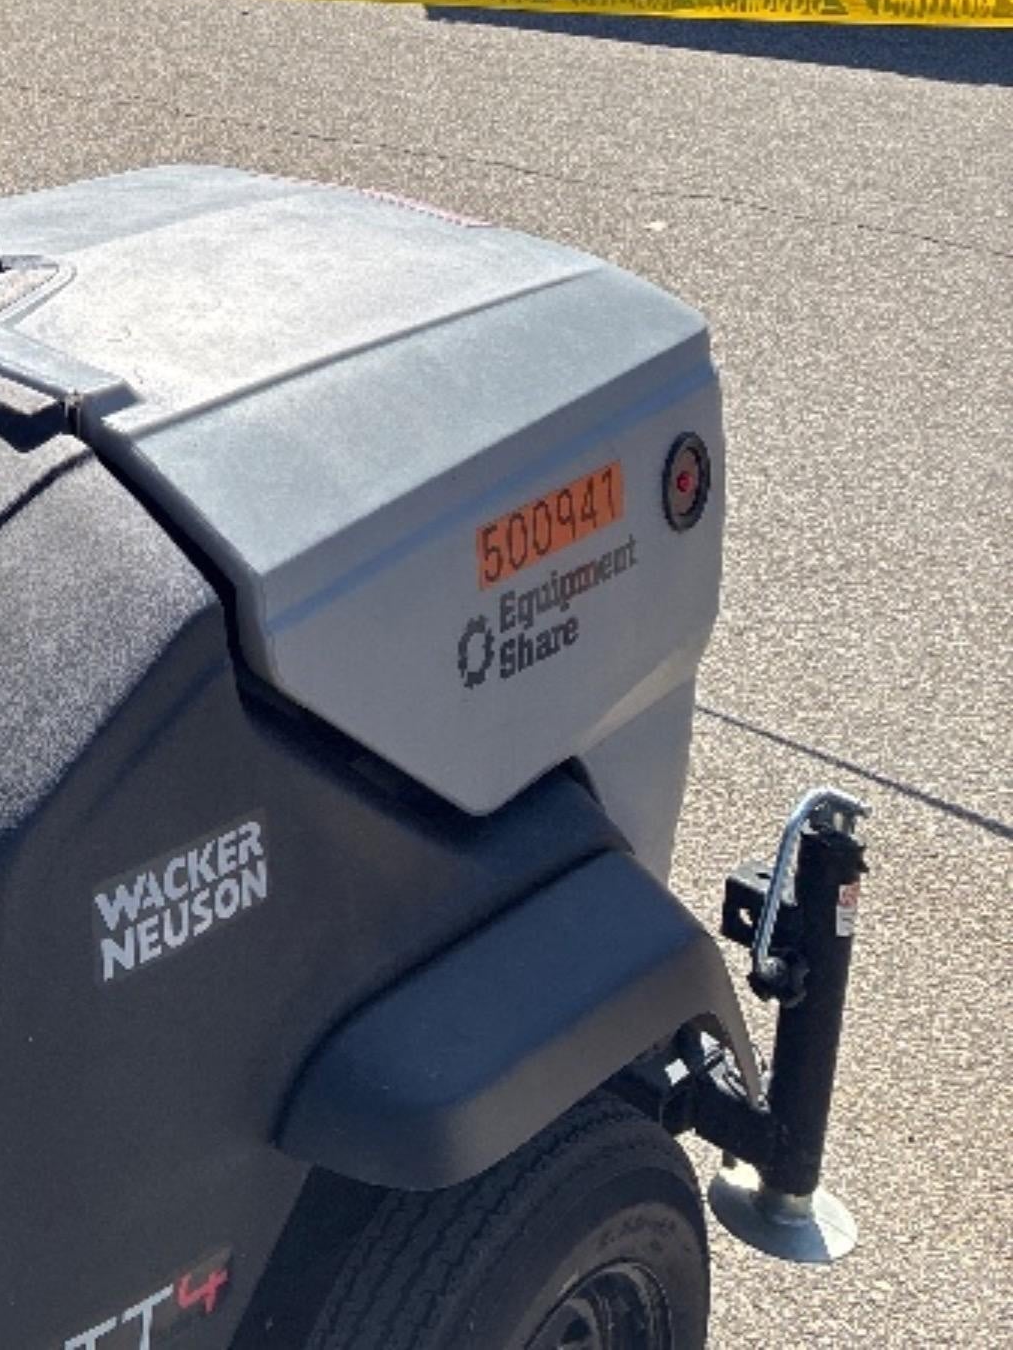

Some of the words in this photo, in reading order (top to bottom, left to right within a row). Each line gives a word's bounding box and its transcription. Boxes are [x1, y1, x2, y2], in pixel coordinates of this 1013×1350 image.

[480, 465, 616, 584] 500941
[499, 534, 638, 633] Equipment
[499, 616, 580, 680] Share
[94, 821, 264, 932] WACKER
[100, 859, 267, 983] NEUSON
